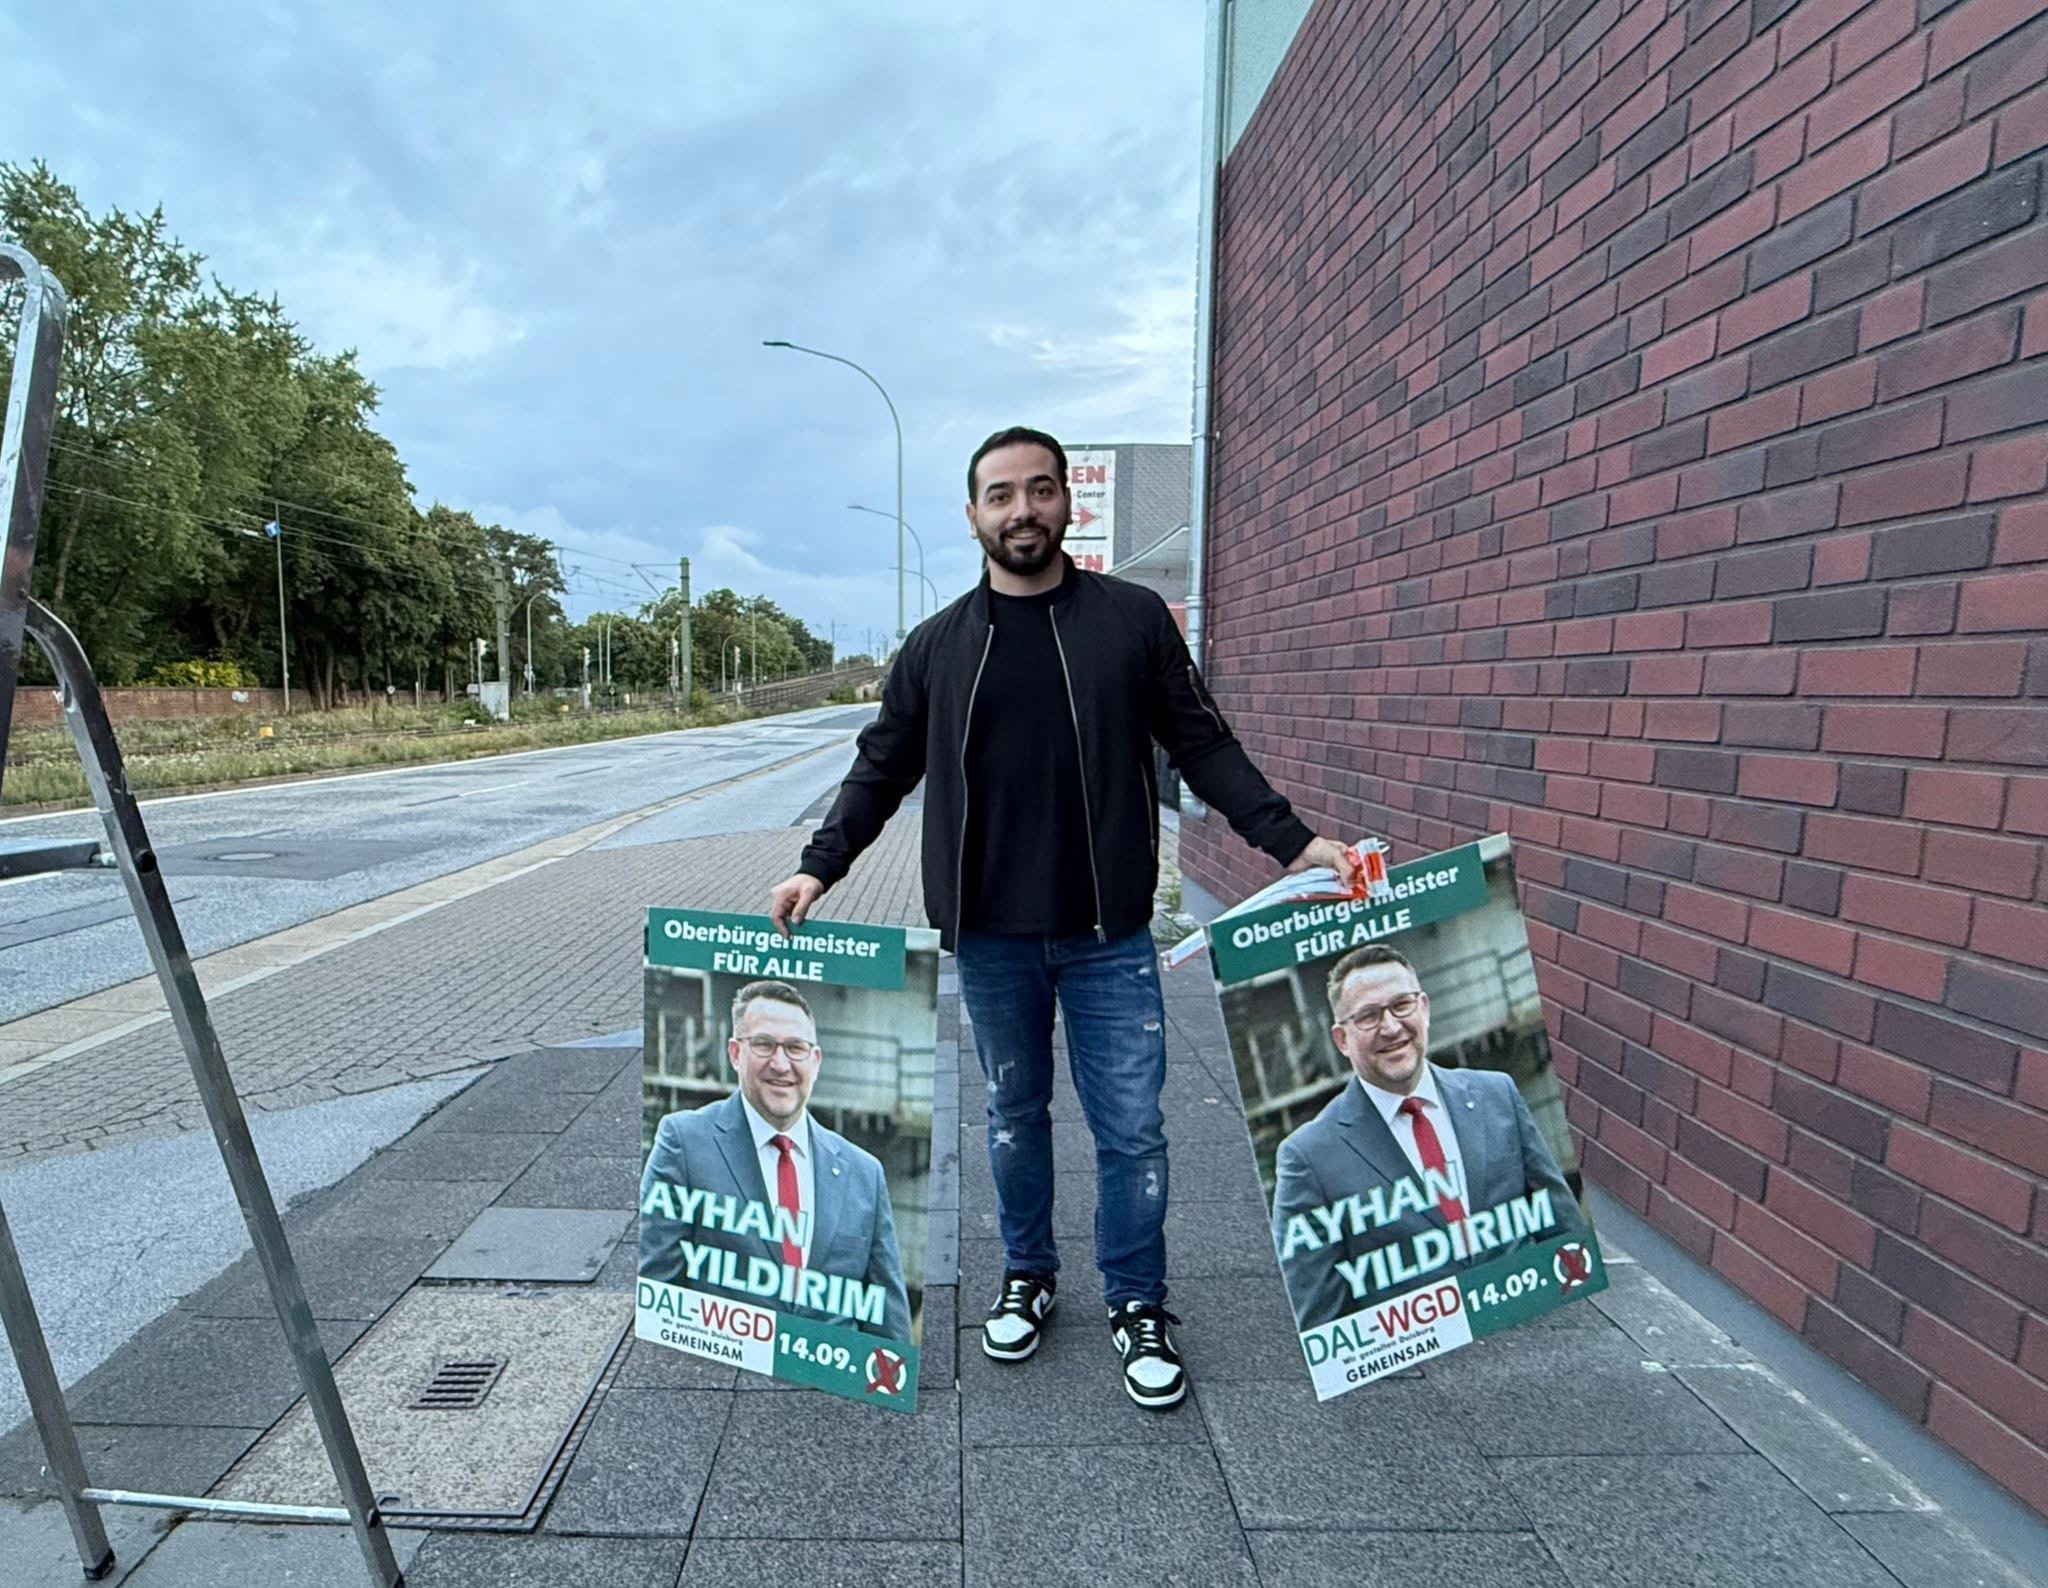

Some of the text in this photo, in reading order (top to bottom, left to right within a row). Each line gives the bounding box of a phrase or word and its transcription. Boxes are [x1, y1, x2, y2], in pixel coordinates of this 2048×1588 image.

[664, 919, 880, 957] Oberbürgermeister
[1295, 908, 1412, 961] FÜR ALLE
[713, 950, 825, 981] FÜR ALLE
[642, 1180, 808, 1247] AYHAN
[1281, 1168, 1462, 1260] AYHAN
[1335, 1188, 1556, 1299] YILDIRIM
[680, 1241, 886, 1325] YILDIRIM
[1467, 1267, 1548, 1312] 14.09.
[637, 1282, 774, 1342] DAL-WGD
[1303, 1284, 1461, 1367] DAL-WGD
[660, 1328, 744, 1362] GEMEINSAM
[779, 1332, 857, 1373] 14.09.
[1346, 1336, 1440, 1383] GEMEINSAM
